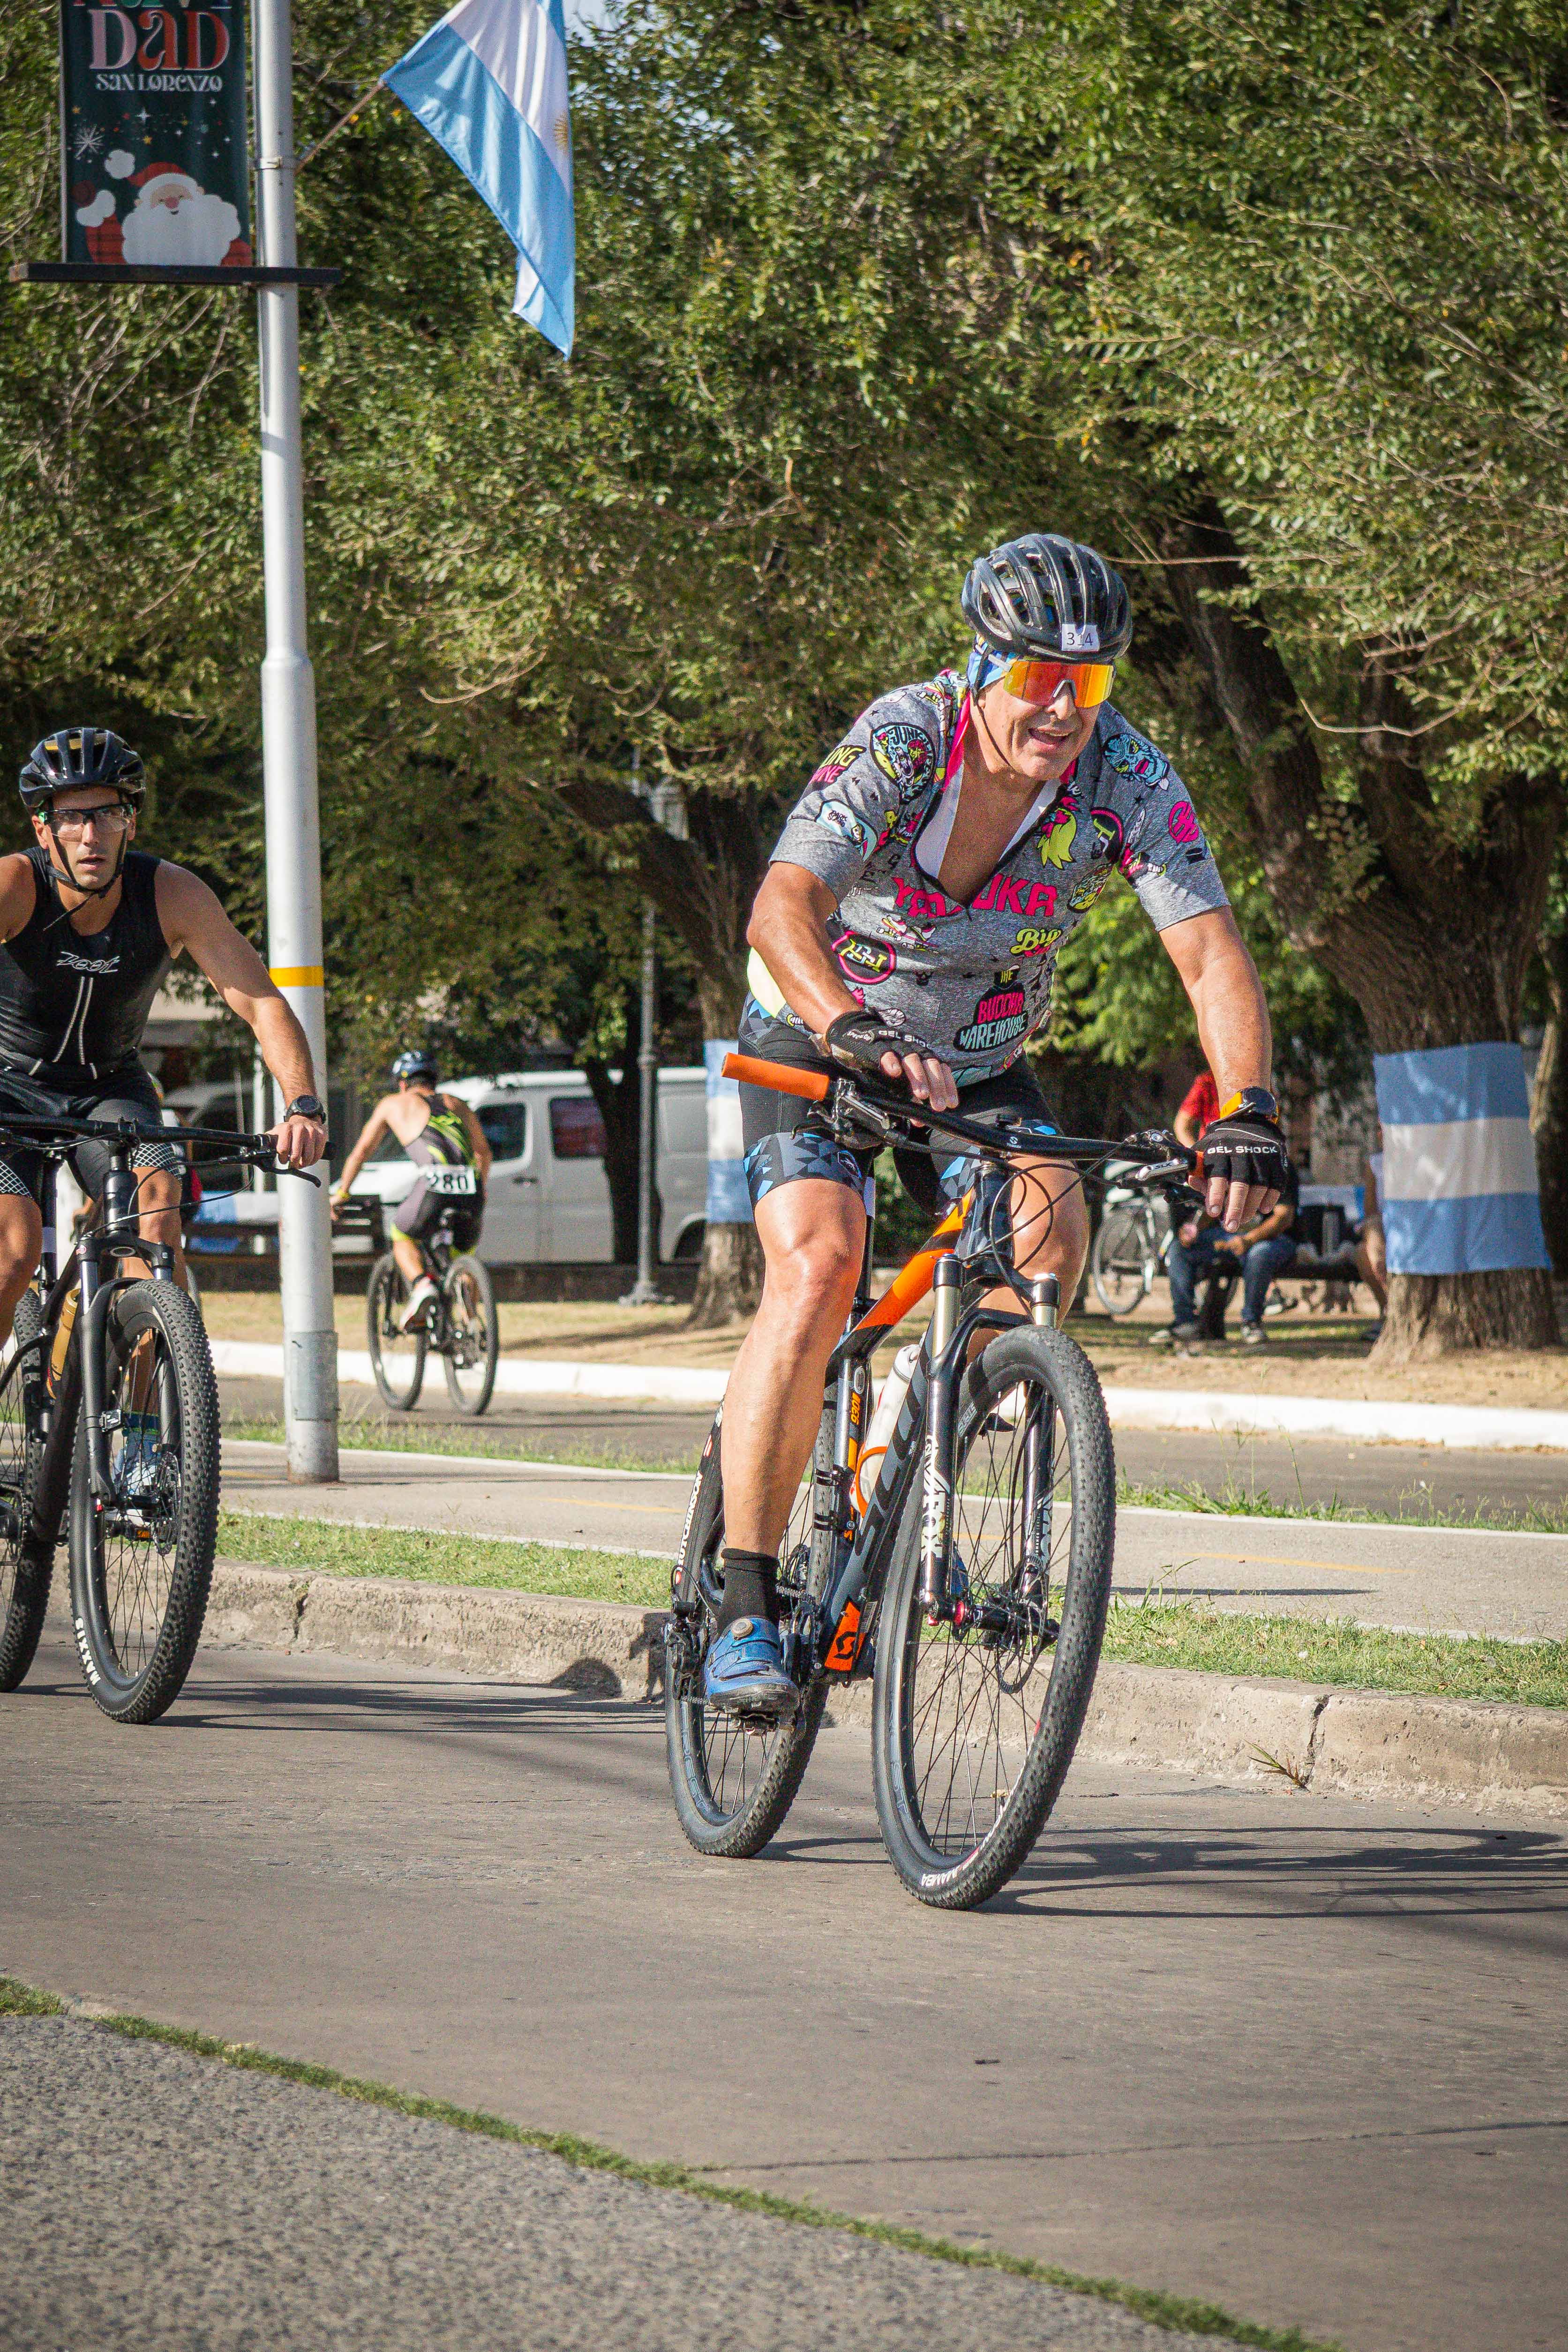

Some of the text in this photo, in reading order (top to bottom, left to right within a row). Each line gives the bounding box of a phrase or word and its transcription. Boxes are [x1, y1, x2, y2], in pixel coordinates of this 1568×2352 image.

[1066, 632, 1093, 646] 314
[977, 992, 1025, 1024] BUDDHA
[960, 1012, 1027, 1050] WAREHOUSE
[1207, 1146, 1279, 1154] GEL SHOCK
[1154, 1162, 1173, 1170] SLX
[75, 1617, 101, 1685] MAXXIS
